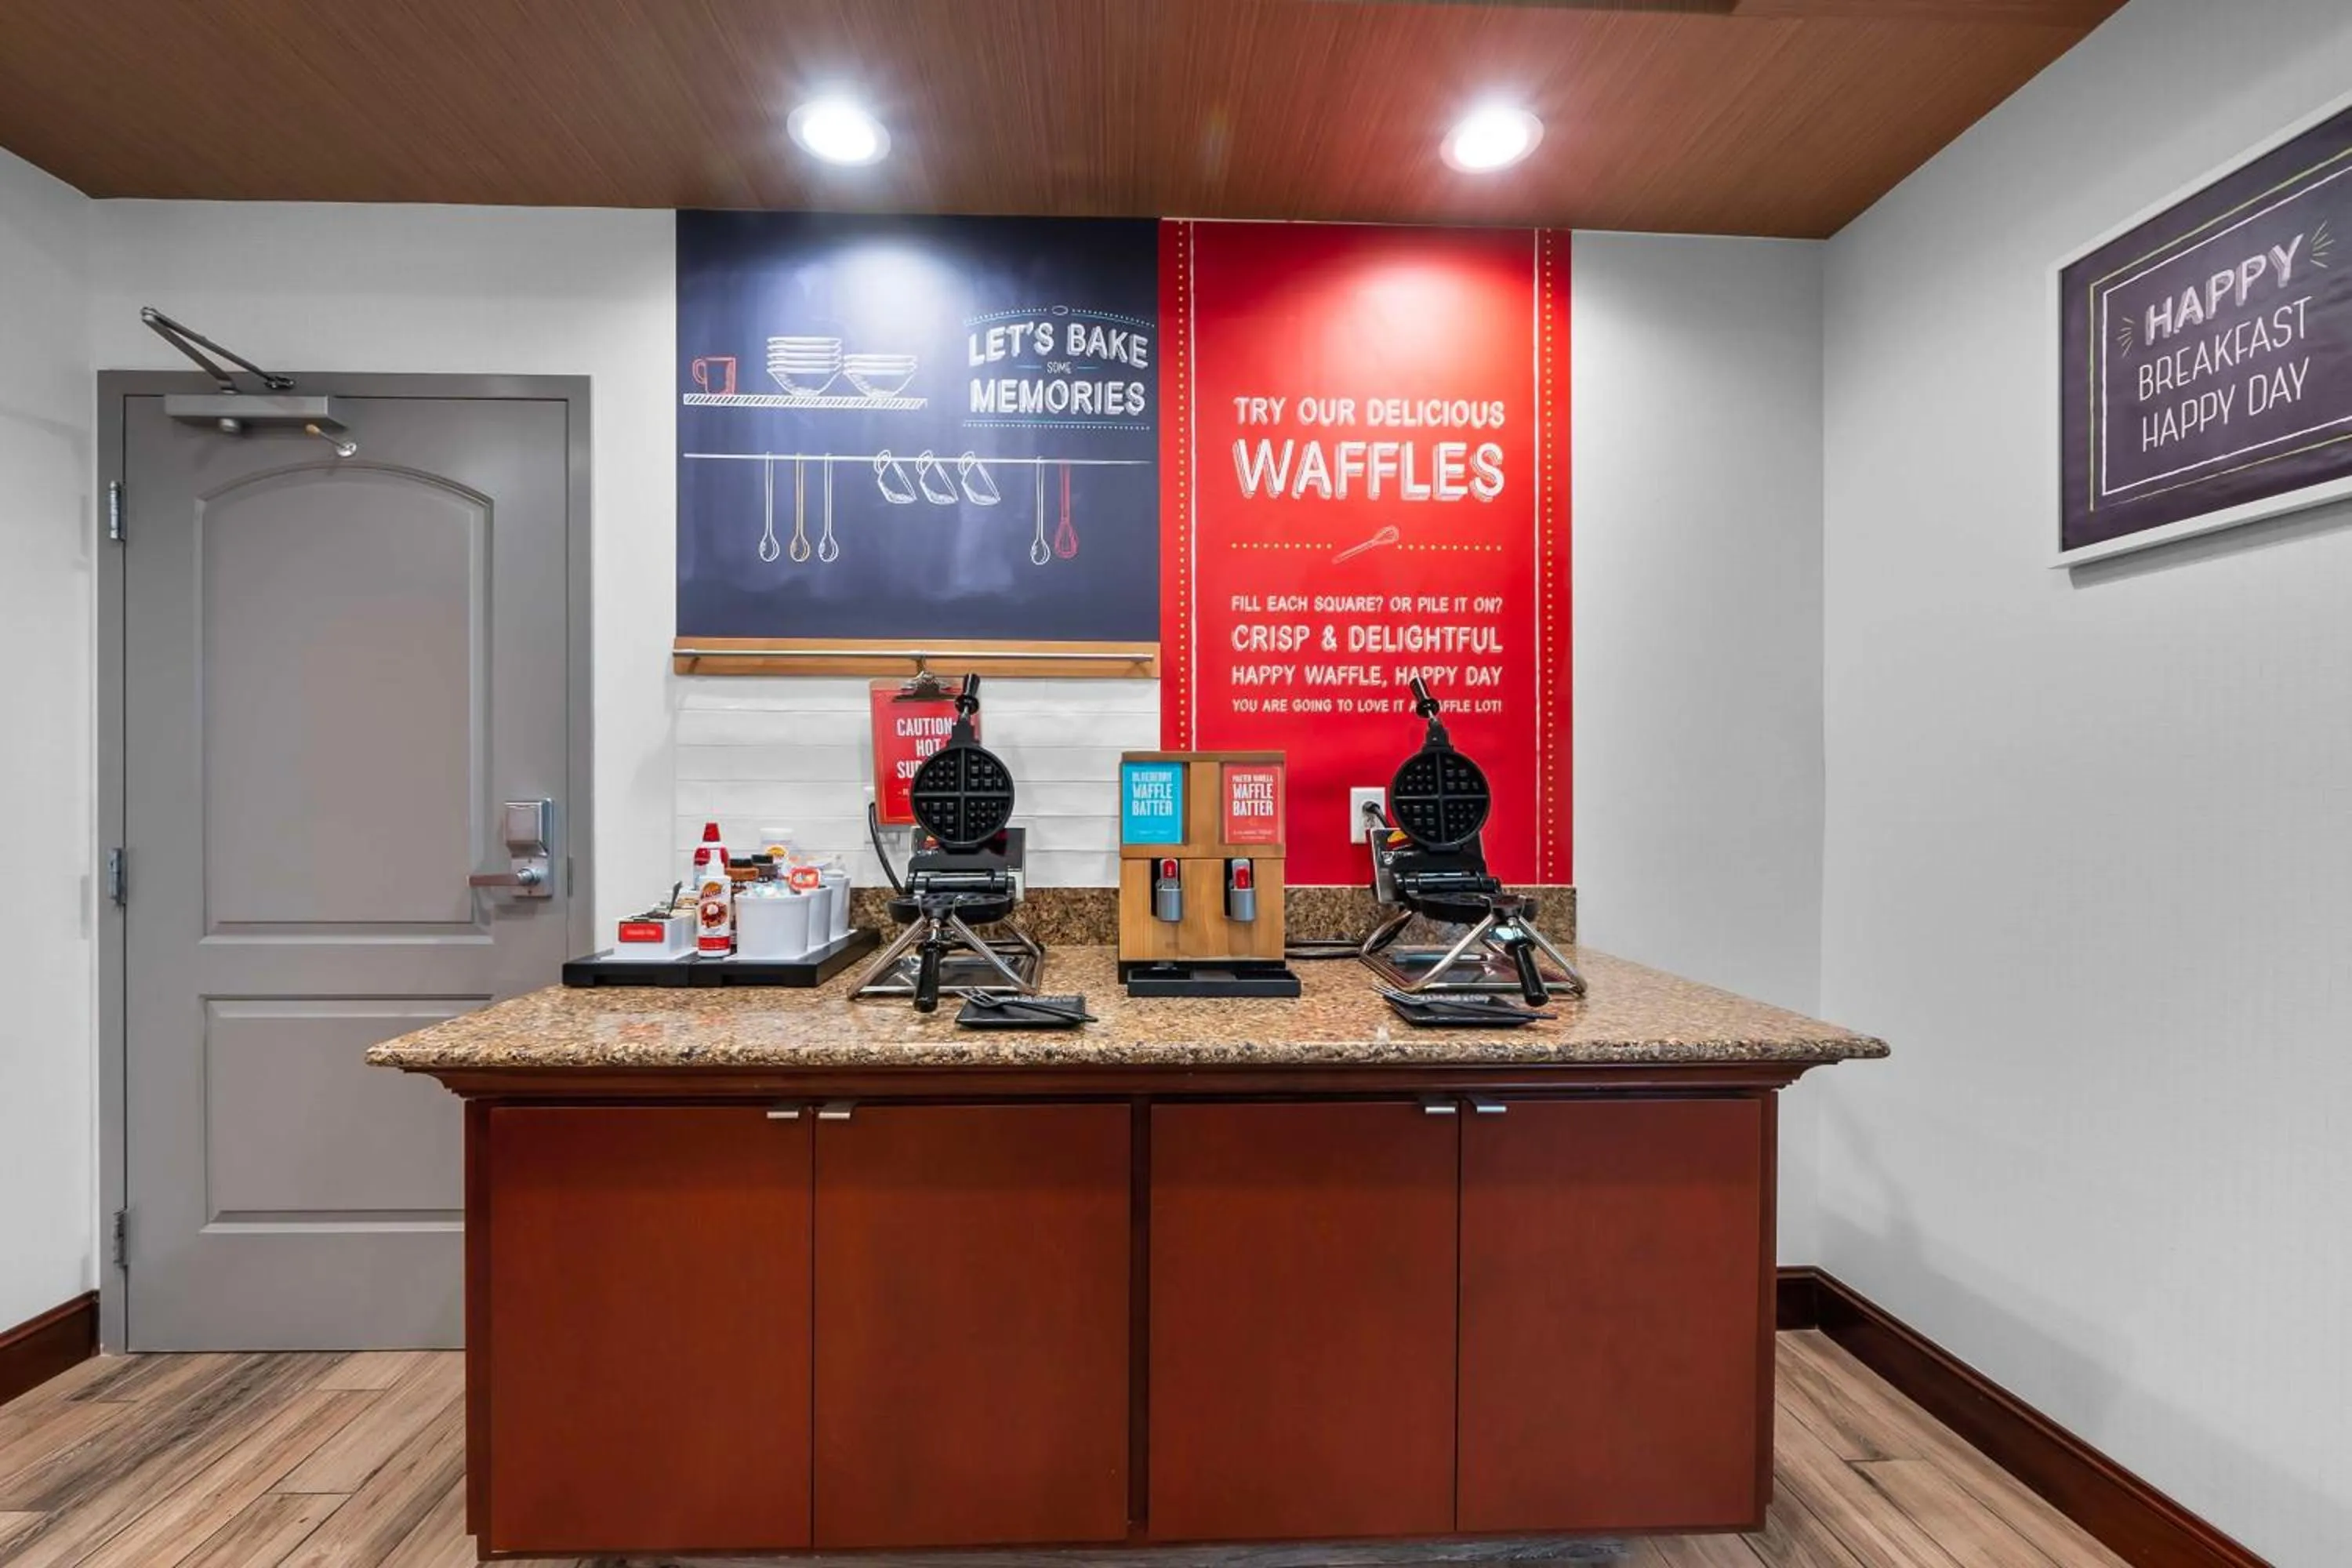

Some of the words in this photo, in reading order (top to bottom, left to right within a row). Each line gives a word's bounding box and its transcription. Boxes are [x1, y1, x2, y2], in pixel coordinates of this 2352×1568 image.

[2145, 233, 2304, 346] HAPPY
[968, 321, 1054, 367] LET'S
[1067, 323, 1149, 368] BAKE
[2139, 296, 2312, 401] BREAKFAST
[1047, 361, 1072, 374] SOME
[970, 379, 1145, 416] MEMORIES
[2142, 384, 2235, 452] HAPPY
[2249, 356, 2310, 416] DAY
[1233, 397, 1286, 426] TRY
[1298, 397, 1356, 427] OUR
[1367, 398, 1505, 430] DELICIOUS
[1232, 438, 1505, 503] WAFFLES
[1231, 595, 1261, 612] FILL
[1266, 595, 1308, 612] EACH
[1314, 595, 1384, 613] SQUARE?
[1389, 596, 1411, 613] OR
[1417, 597, 1449, 613] PILE
[1454, 597, 1468, 613] IT
[1473, 597, 1503, 614] ON?
[1231, 624, 1310, 653] CRISP
[1321, 624, 1338, 652] &
[1348, 625, 1504, 655] DELIGHTFUL
[1231, 665, 1296, 686] HAPPY
[1305, 665, 1388, 688] WAFFLE,
[1395, 666, 1458, 686] HAPPY
[1465, 666, 1503, 686] DAY
[1232, 699, 1258, 712] YOU
[1262, 699, 1288, 712] ARE
[1292, 699, 1332, 713] GOING
[1337, 699, 1353, 712] TO
[1357, 699, 1389, 713] LOVE
[1393, 699, 1404, 713] IT
[916, 738, 941, 757] HOT
[1133, 783, 1174, 799] WAFFLE
[1232, 783, 1273, 799] WAFFLE
[1132, 800, 1173, 816] BATTER
[1232, 800, 1273, 816] BATTER
